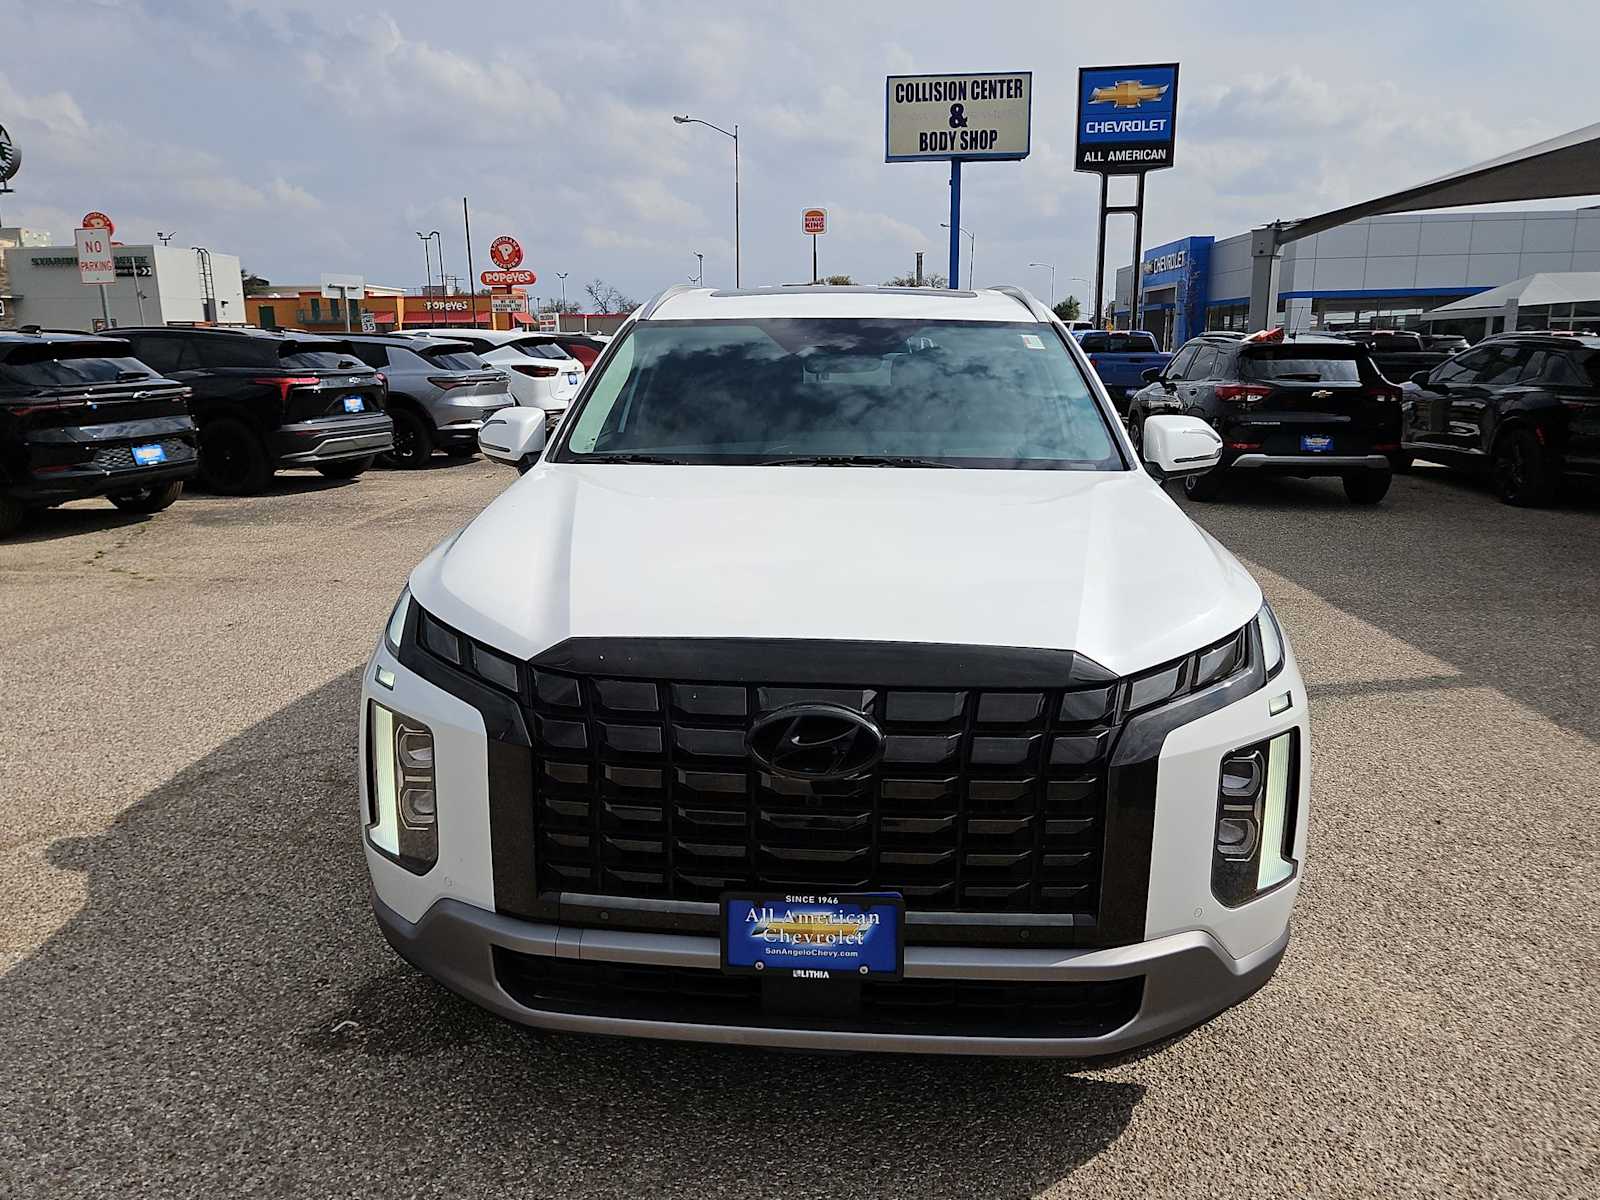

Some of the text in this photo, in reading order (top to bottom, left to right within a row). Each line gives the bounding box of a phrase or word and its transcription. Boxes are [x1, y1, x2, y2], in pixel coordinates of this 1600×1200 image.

[895, 79, 1023, 103] COLLISION CENTER
[949, 103, 968, 128] &
[1086, 119, 1167, 133] CHEVROLET
[920, 130, 998, 152] BODY SHOP
[1084, 149, 1166, 162] ALL AMERICAN
[85, 240, 102, 253] NO
[80, 260, 113, 271] PARKING
[1153, 251, 1186, 274] CHEVROLET
[364, 323, 375, 331] 35
[785, 895, 839, 905] SINCE 1946
[745, 908, 880, 925] All American
[763, 928, 864, 946] Chevrolet
[765, 947, 858, 958] SanAngeloChevy.com
